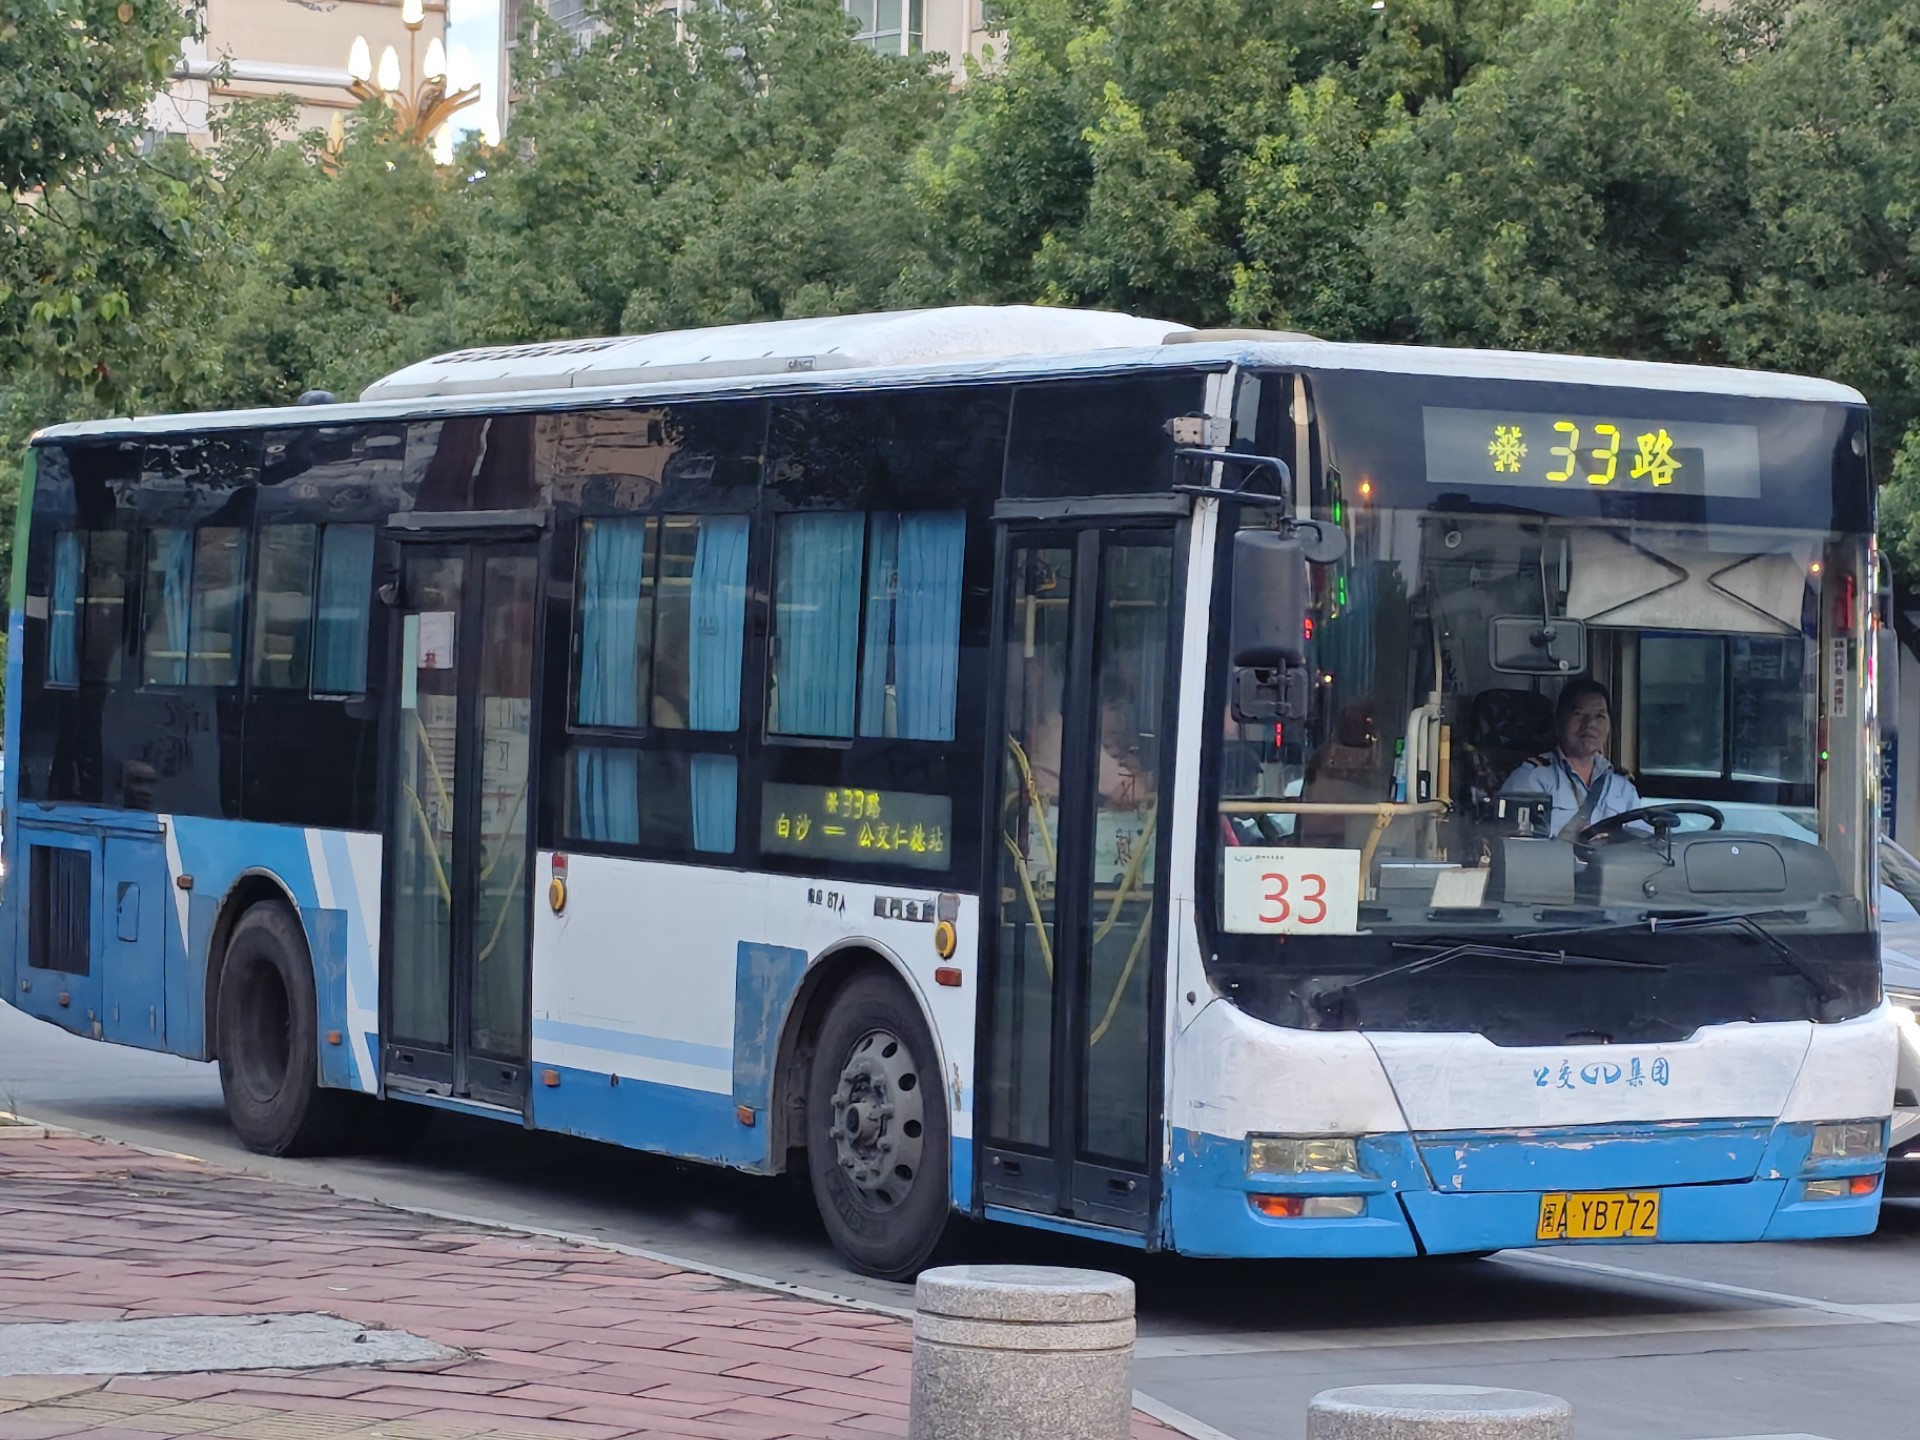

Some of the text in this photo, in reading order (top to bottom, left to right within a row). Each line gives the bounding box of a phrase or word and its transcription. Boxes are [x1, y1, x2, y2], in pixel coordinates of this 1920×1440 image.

[1546, 421, 1682, 487] 33路
[777, 813, 812, 840] 白沙
[1258, 872, 1327, 924] 33
